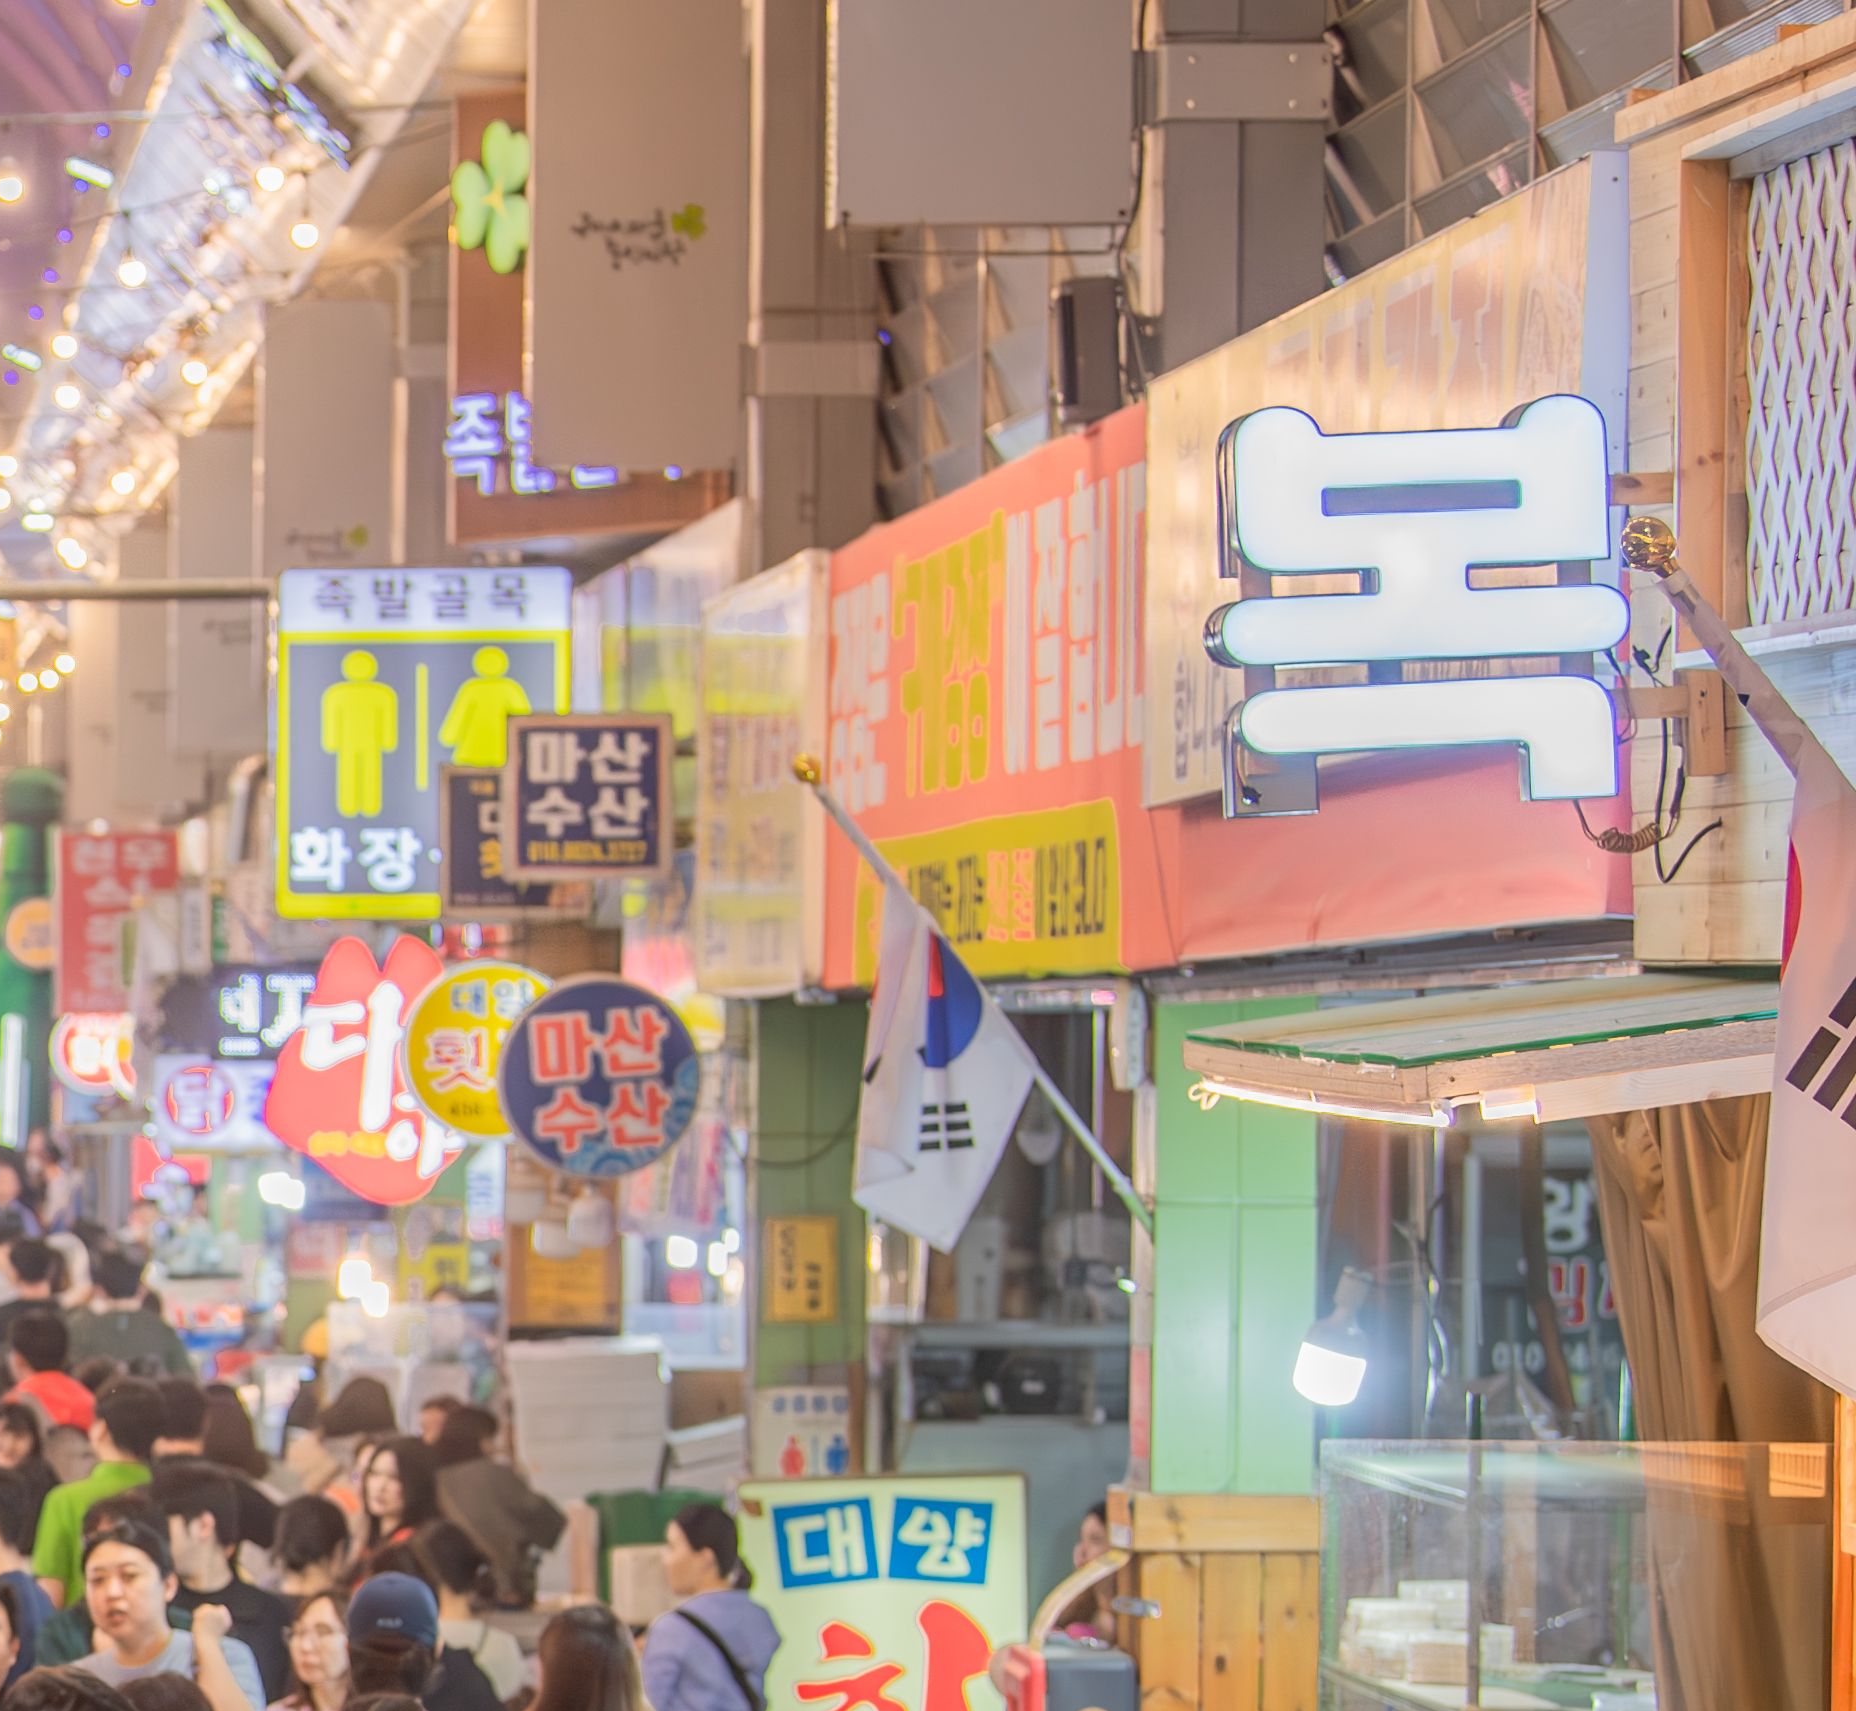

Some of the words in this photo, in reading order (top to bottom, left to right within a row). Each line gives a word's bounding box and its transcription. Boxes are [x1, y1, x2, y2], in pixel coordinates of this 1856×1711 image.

[314, 574, 530, 621] 족발골목
[527, 731, 652, 785] 마산
[527, 792, 651, 840] 수산
[528, 1004, 670, 1083] 마산
[536, 1080, 672, 1153] 수산
